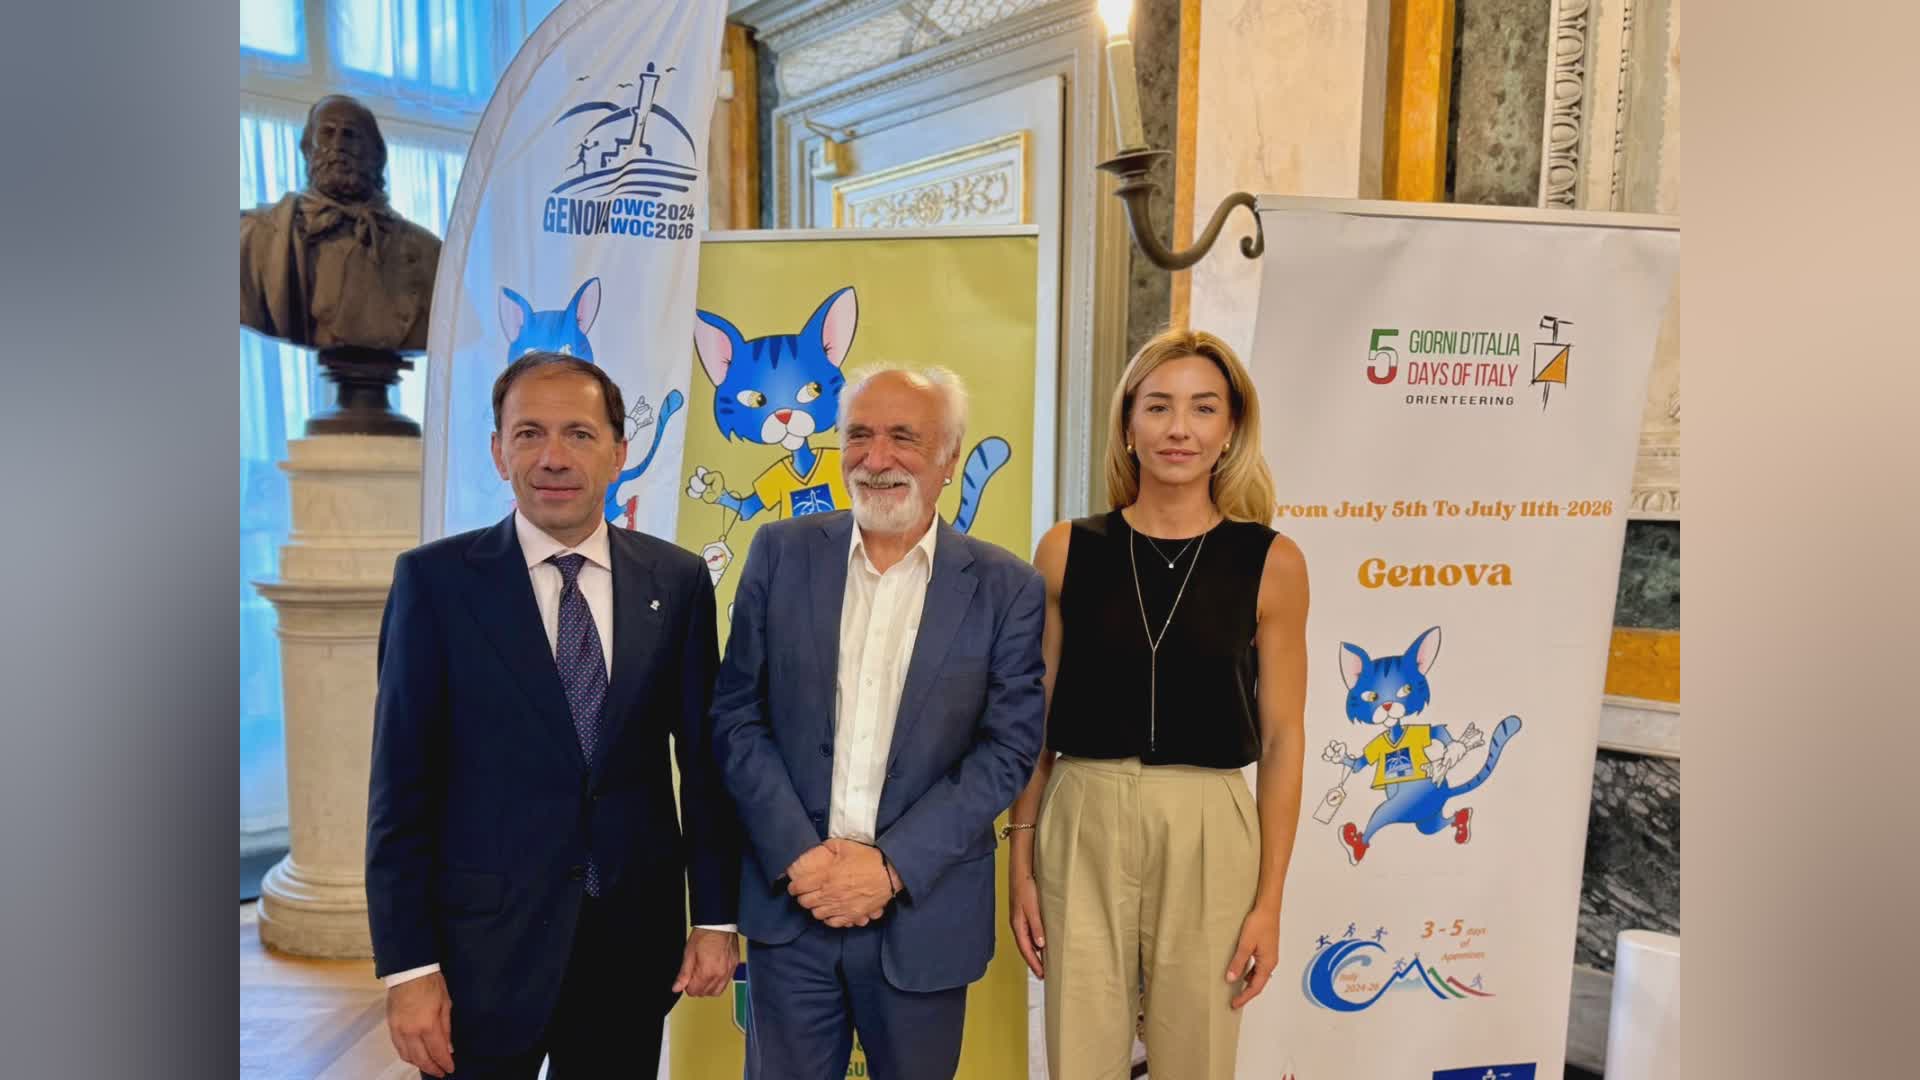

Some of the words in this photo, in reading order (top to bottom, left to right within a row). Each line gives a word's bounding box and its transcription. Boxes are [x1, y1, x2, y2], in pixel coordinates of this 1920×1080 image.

[543, 196, 611, 236] GENOVA
[1409, 329, 1457, 354] GIORNI
[1459, 331, 1520, 356] D'ITALIA
[1367, 328, 1399, 385] 5
[1407, 362, 1448, 385] DAYS
[1452, 362, 1470, 386] OF
[1474, 363, 1518, 387] ITALY
[1406, 394, 1514, 406] ORIENTEERING
[1273, 501, 1328, 518] rom
[1334, 500, 1388, 522] July
[1391, 500, 1428, 518] 5th
[1433, 500, 1461, 518] To
[1465, 500, 1516, 521] July
[1357, 557, 1513, 589] Genova
[1421, 920, 1435, 938] 3
[1449, 919, 1465, 937] 5
